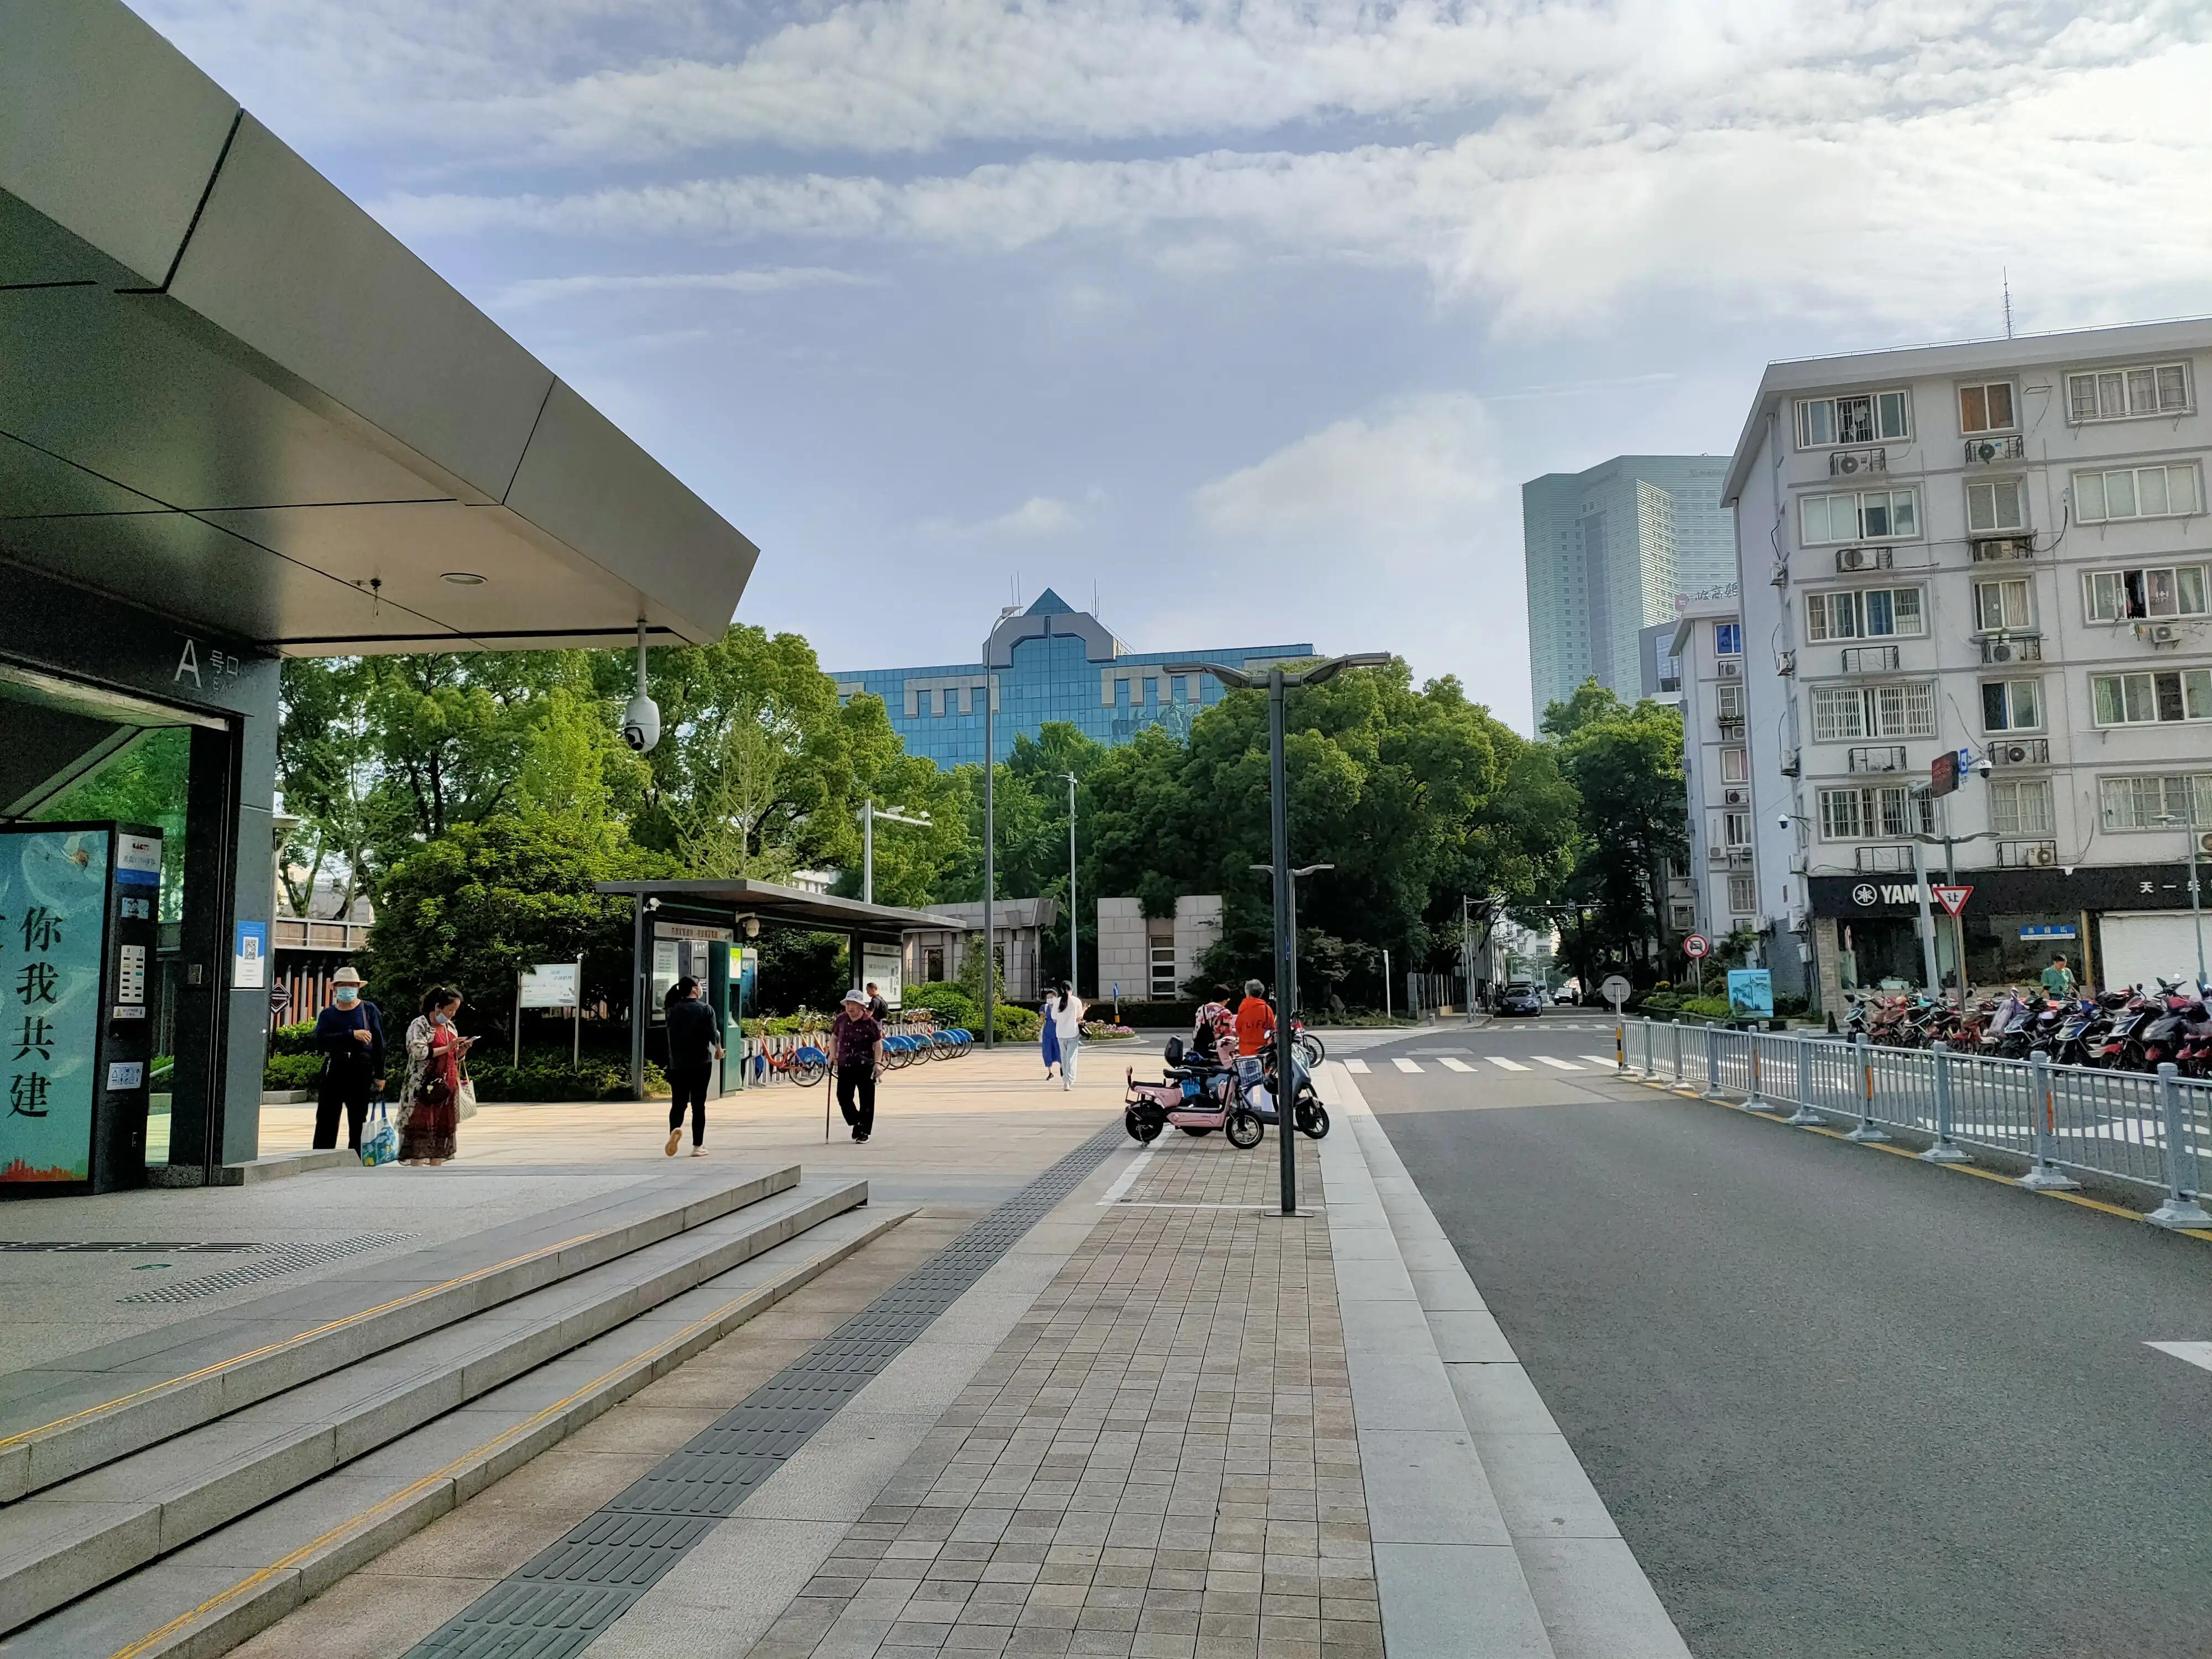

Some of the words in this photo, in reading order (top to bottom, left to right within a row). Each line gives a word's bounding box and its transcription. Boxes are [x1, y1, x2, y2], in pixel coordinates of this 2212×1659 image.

[174, 639, 202, 688] A
[209, 650, 239, 677] 号口
[1881, 884, 1945, 904] YAMAH
[2140, 879, 2212, 894] 天一乐
[1946, 892, 1959, 902] 让
[7, 906, 62, 1118] 你我共建
